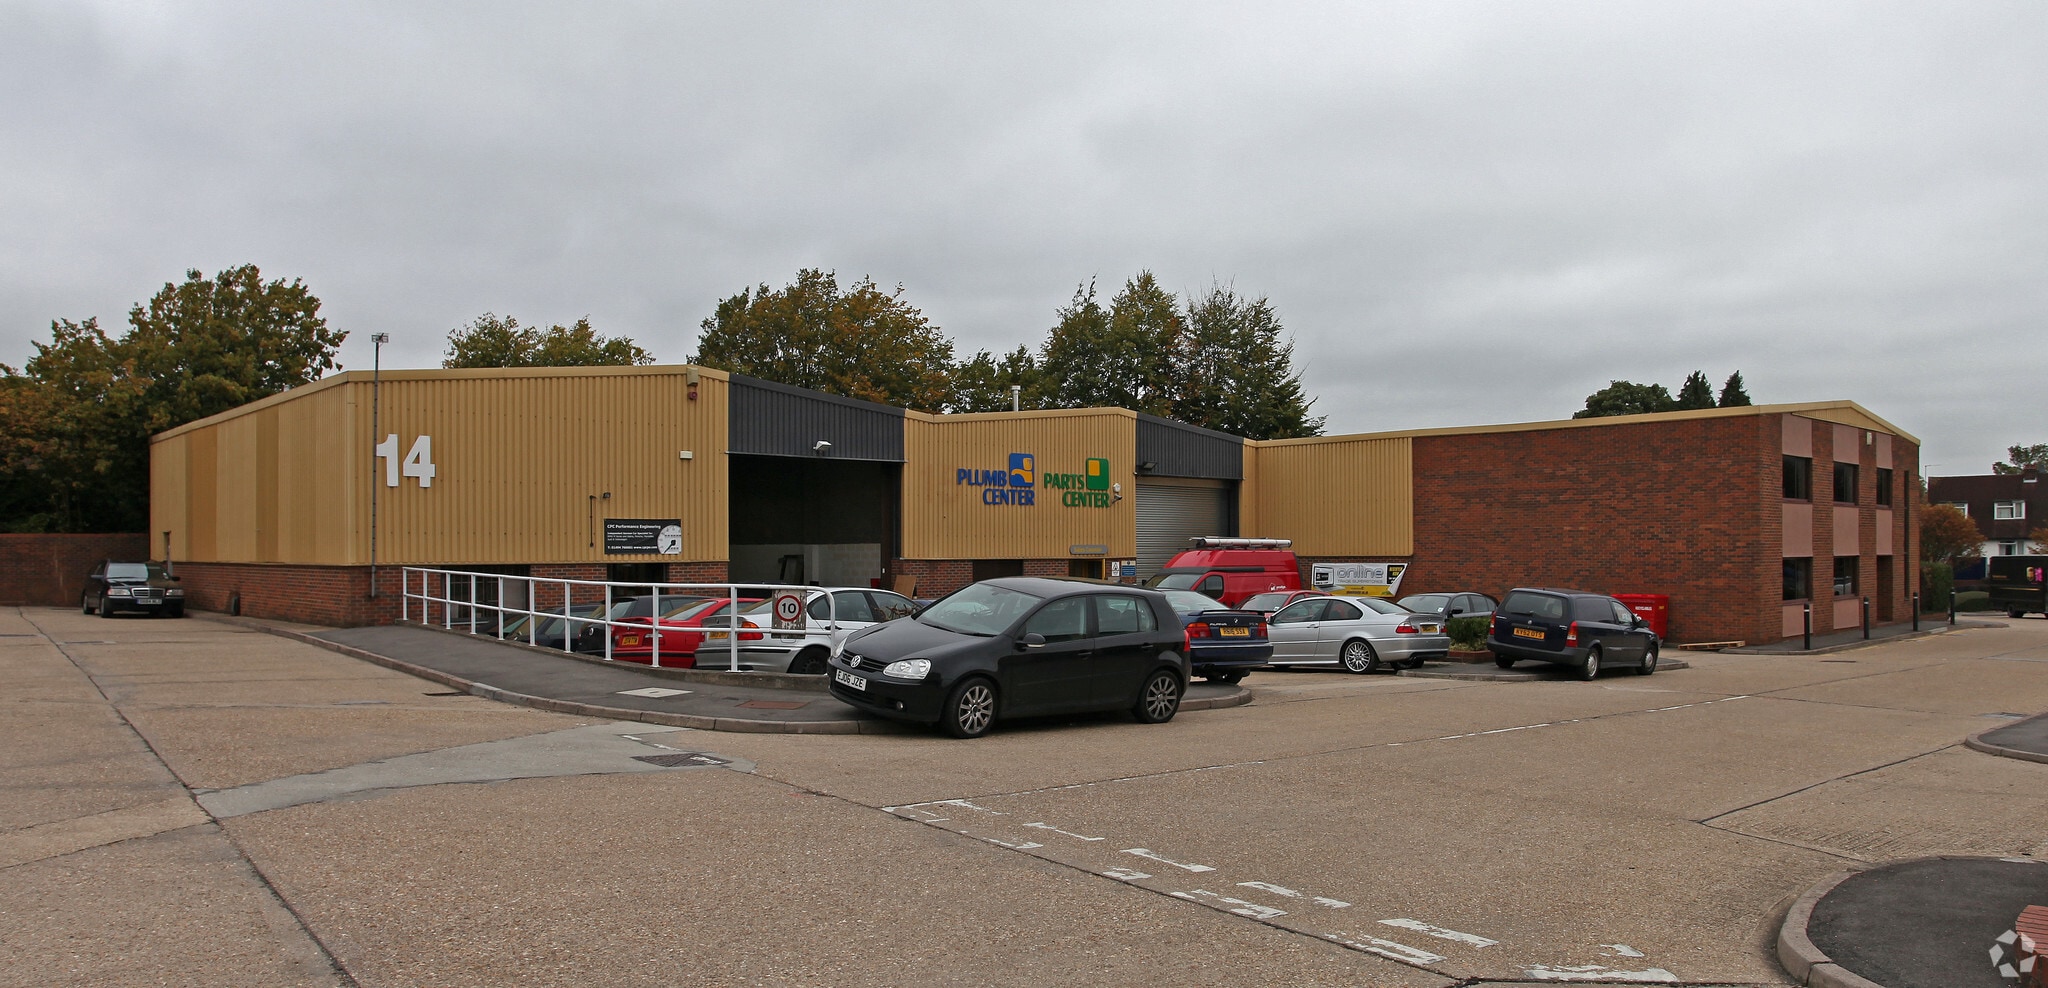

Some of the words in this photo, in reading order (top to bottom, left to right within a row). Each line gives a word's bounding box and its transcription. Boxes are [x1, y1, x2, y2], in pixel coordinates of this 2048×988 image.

[376, 433, 436, 488] 14
[957, 468, 1007, 487] PLUMB
[1043, 472, 1084, 489] PARTS
[982, 488, 1035, 506] CENTER
[1062, 491, 1110, 508] CENTER
[1337, 565, 1384, 579] online
[781, 602, 797, 614] 10
[838, 670, 851, 684] EJ06
[851, 676, 864, 689] JZE
